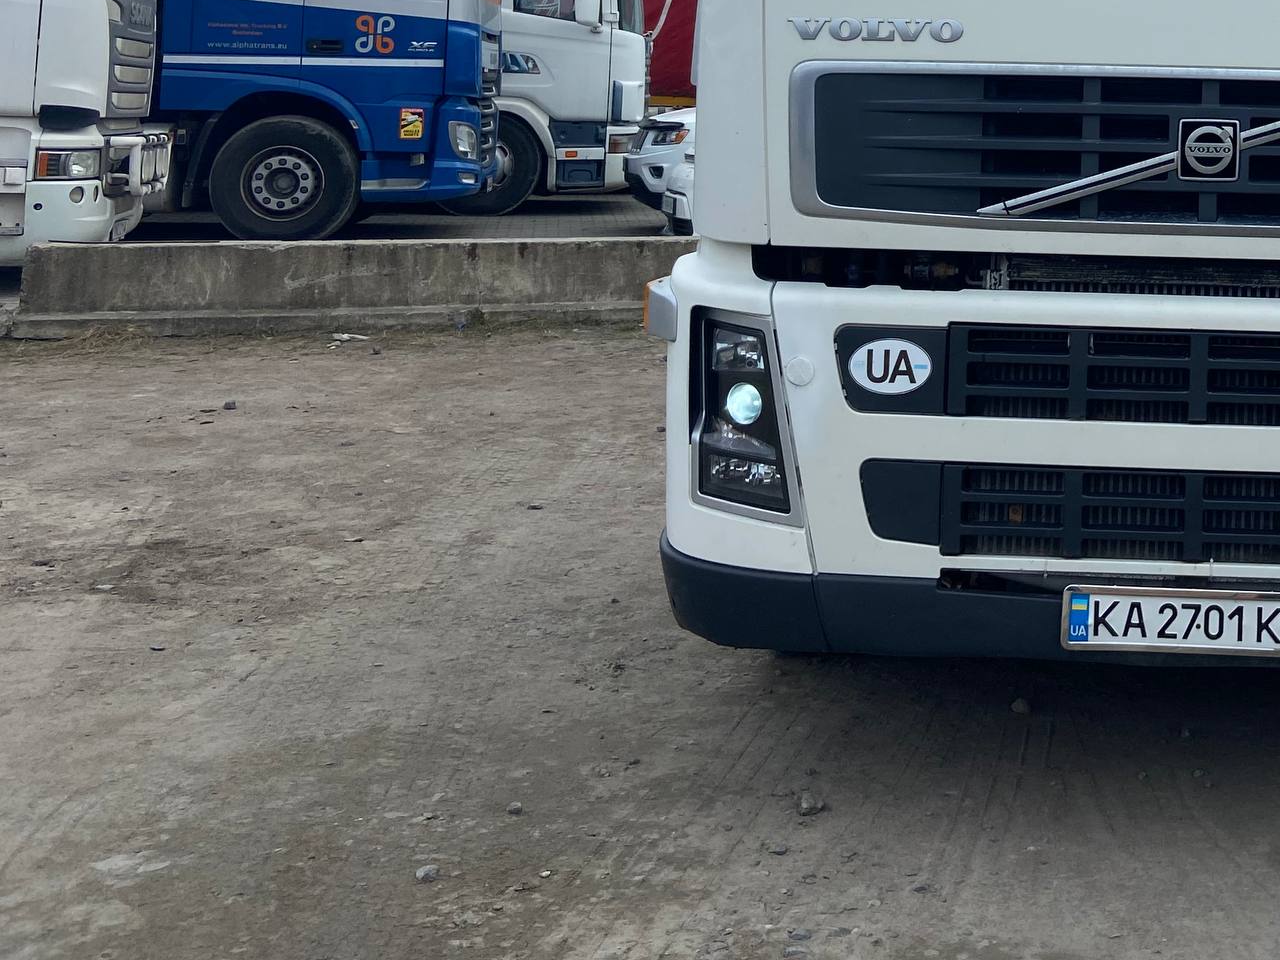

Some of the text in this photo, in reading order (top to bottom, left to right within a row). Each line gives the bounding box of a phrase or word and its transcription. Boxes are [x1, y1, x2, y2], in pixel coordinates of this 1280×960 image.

[787, 16, 964, 43] VOLVO
[409, 41, 438, 49] XF
[1187, 146, 1231, 154] VOLVO
[866, 349, 917, 384] UA
[1070, 625, 1087, 636] UA
[1093, 600, 1147, 638] KA
[1157, 603, 1244, 642] 2701
